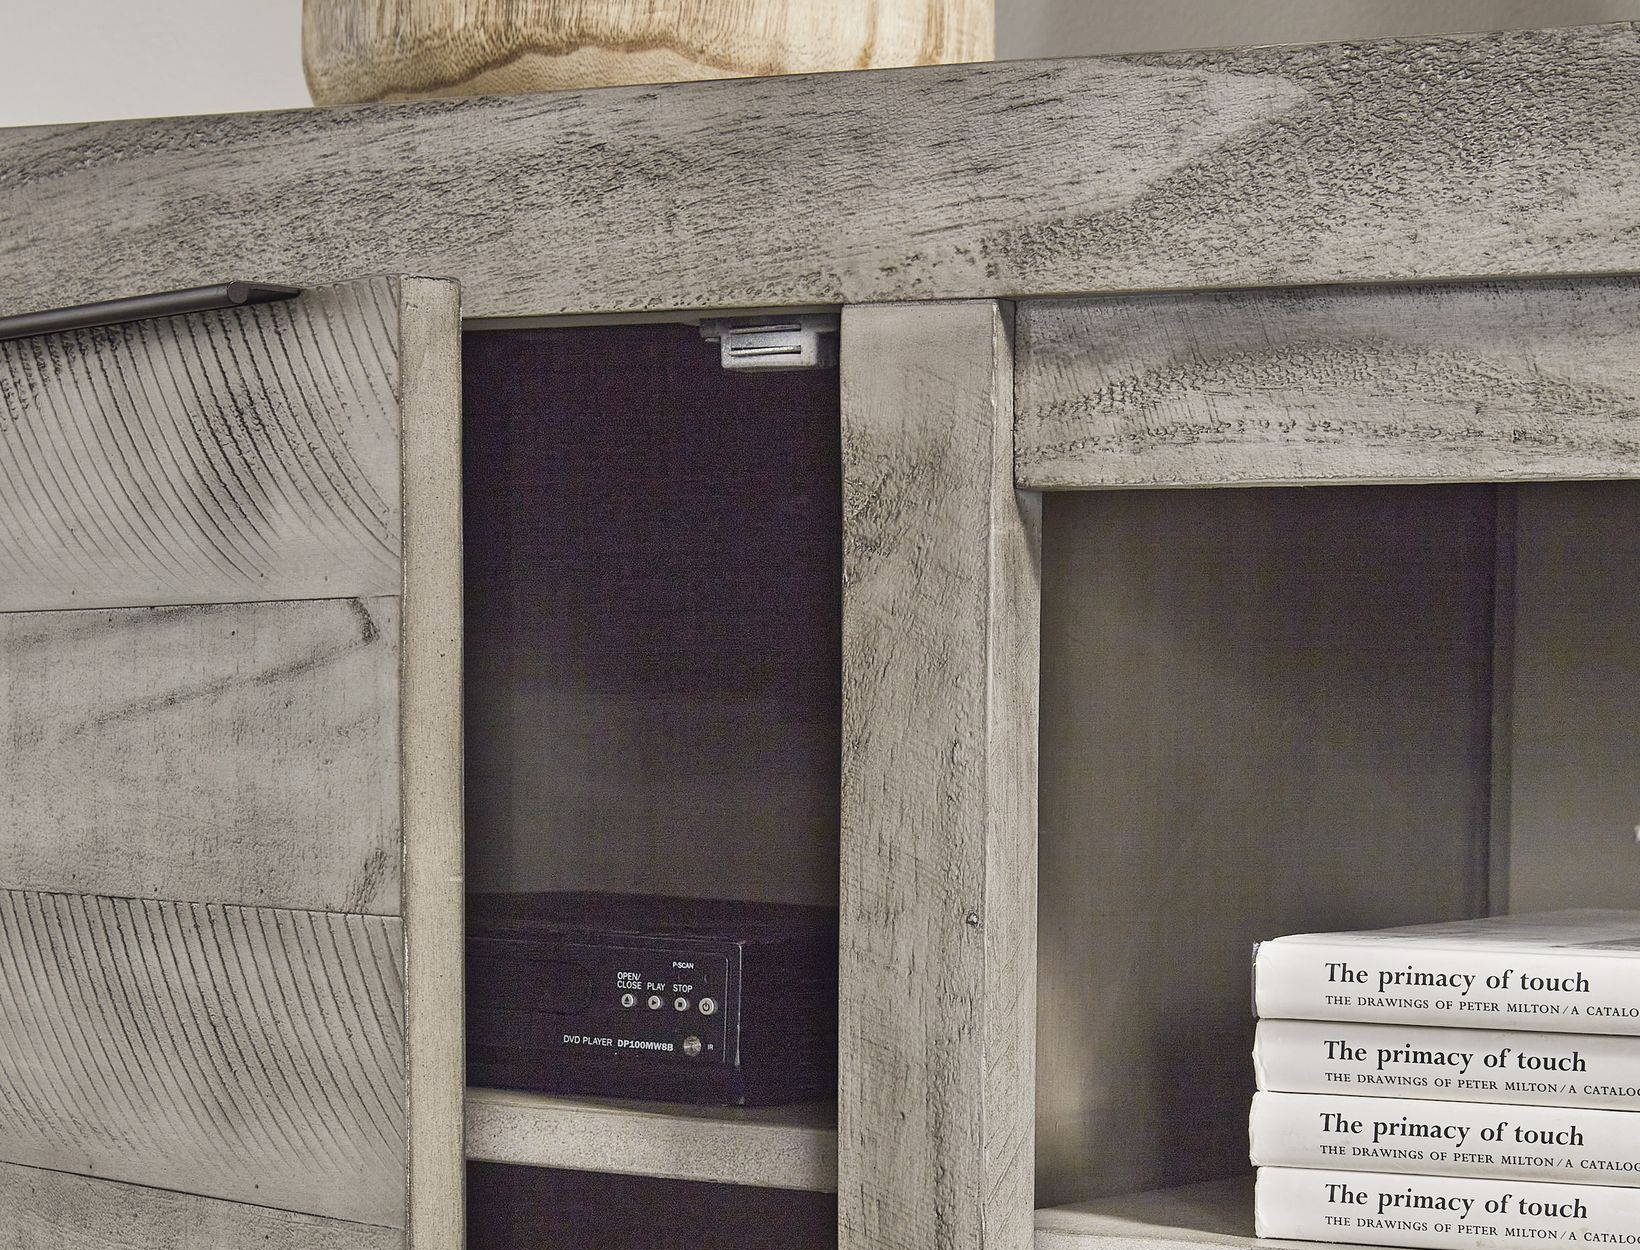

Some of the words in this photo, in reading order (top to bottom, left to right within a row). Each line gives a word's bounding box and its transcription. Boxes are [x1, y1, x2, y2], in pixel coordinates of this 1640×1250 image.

[617, 972, 641, 980] OPEN/
[1325, 963, 1368, 983] The
[1378, 966, 1475, 996] primacy
[1486, 970, 1513, 989] of
[1521, 972, 1589, 992] touch
[617, 981, 642, 989] CLOSE
[647, 982, 665, 991] PLAY
[673, 984, 692, 993] STOP
[1326, 996, 1351, 1005] THE
[1358, 997, 1428, 1008] DRAWINGS
[1436, 1000, 1452, 1009] OF
[1460, 1002, 1500, 1011] PETER
[563, 1035, 580, 1044] DVD
[582, 1037, 612, 1046] PLAYER
[618, 1040, 673, 1051] DP100MW8B
[1324, 1041, 1367, 1061] The
[1377, 1044, 1473, 1074] primacy
[1484, 1048, 1511, 1068] of
[1517, 1052, 1586, 1072] touch
[1325, 1073, 1351, 1082] THE
[1357, 1075, 1427, 1086] DRAWINGS
[1435, 1078, 1451, 1087] OF
[1458, 1080, 1498, 1089] PETER
[1320, 1113, 1362, 1133] The
[1373, 1117, 1470, 1147] primacy
[1481, 1122, 1508, 1141] of
[1515, 1126, 1583, 1146] touch
[1320, 1145, 1345, 1155] THE
[1352, 1147, 1423, 1159] DRAWINGS
[1430, 1152, 1447, 1160] OF
[1454, 1153, 1494, 1163] PETER
[1325, 1184, 1367, 1205] The
[1377, 1188, 1474, 1219] primacy
[1485, 1194, 1512, 1213] of
[1519, 1199, 1587, 1218] touch
[1325, 1216, 1350, 1226] THE
[1358, 1218, 1427, 1231] DRAWINGS
[1435, 1224, 1451, 1232] OF
[1458, 1225, 1498, 1235] PETER
